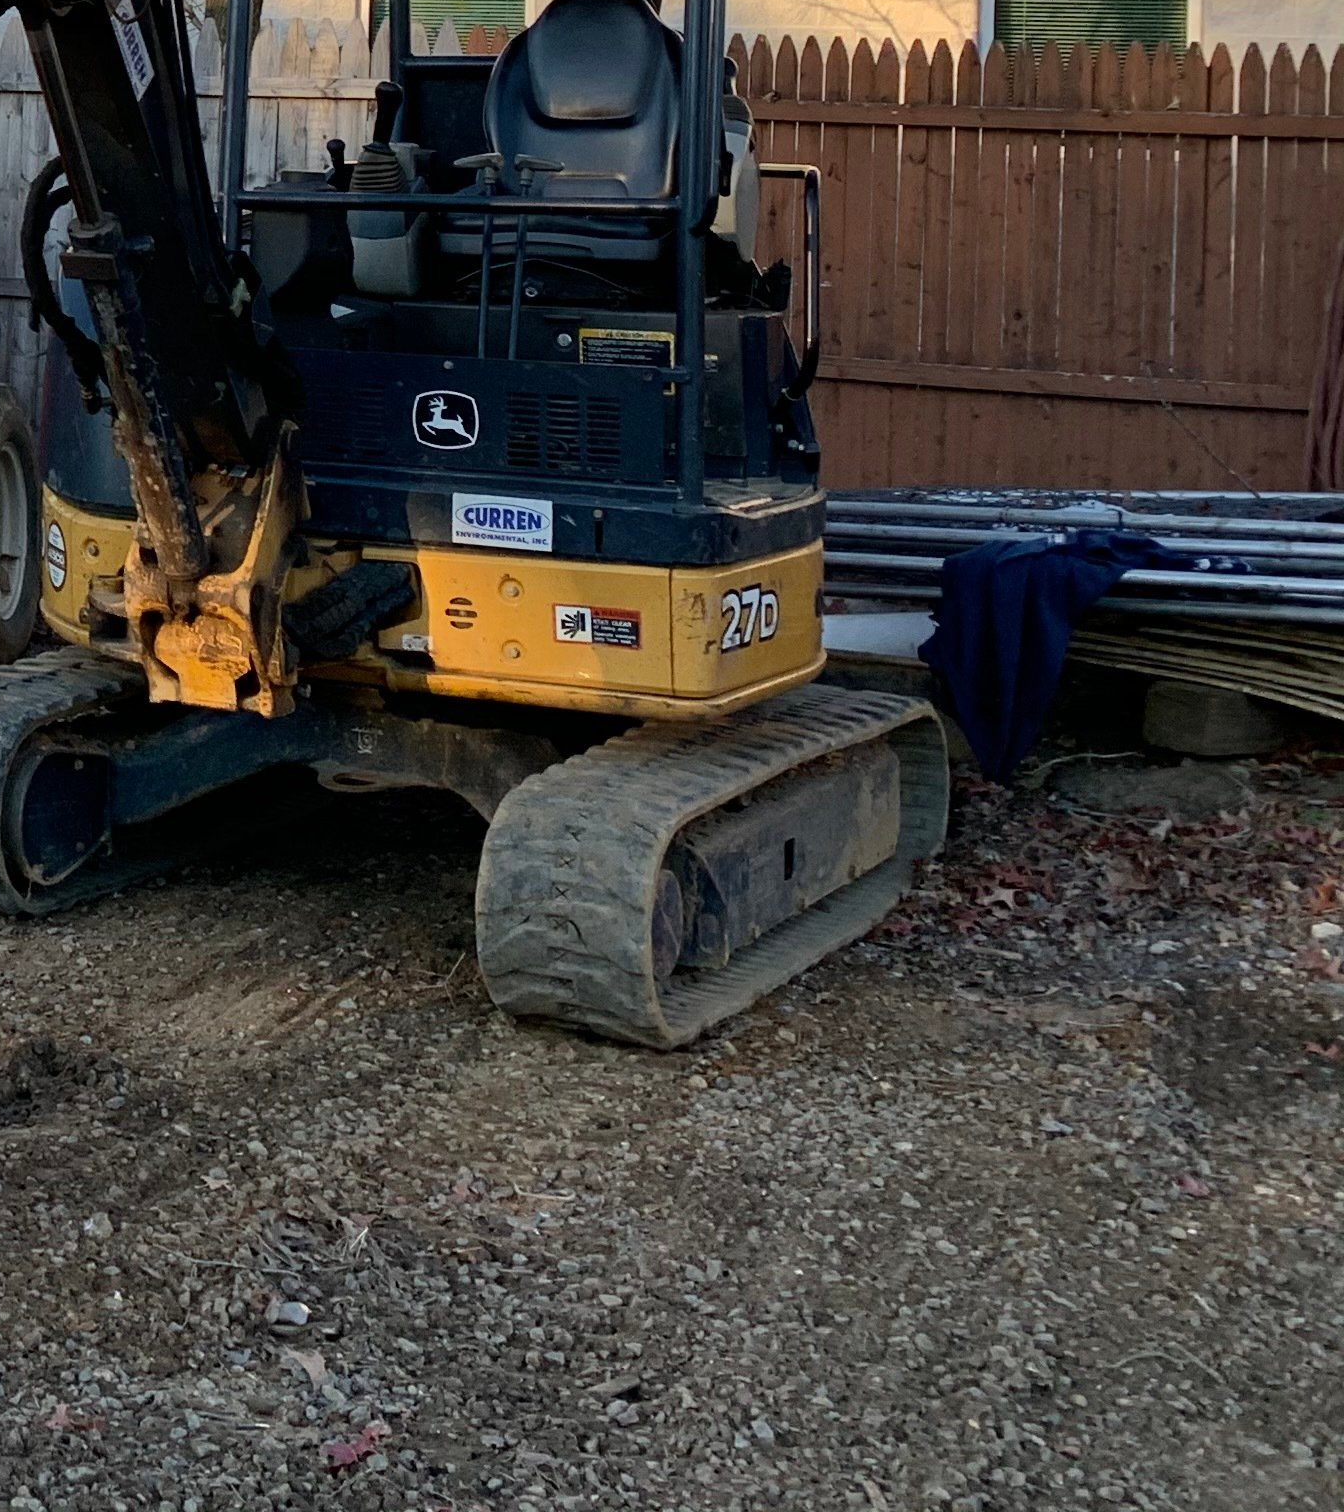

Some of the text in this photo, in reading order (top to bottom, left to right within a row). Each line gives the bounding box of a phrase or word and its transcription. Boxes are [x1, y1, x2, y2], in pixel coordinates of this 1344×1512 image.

[463, 507, 542, 530] CURREN
[455, 530, 549, 546] ENVIRONMENTAL, INC.
[721, 583, 779, 654] 27D
